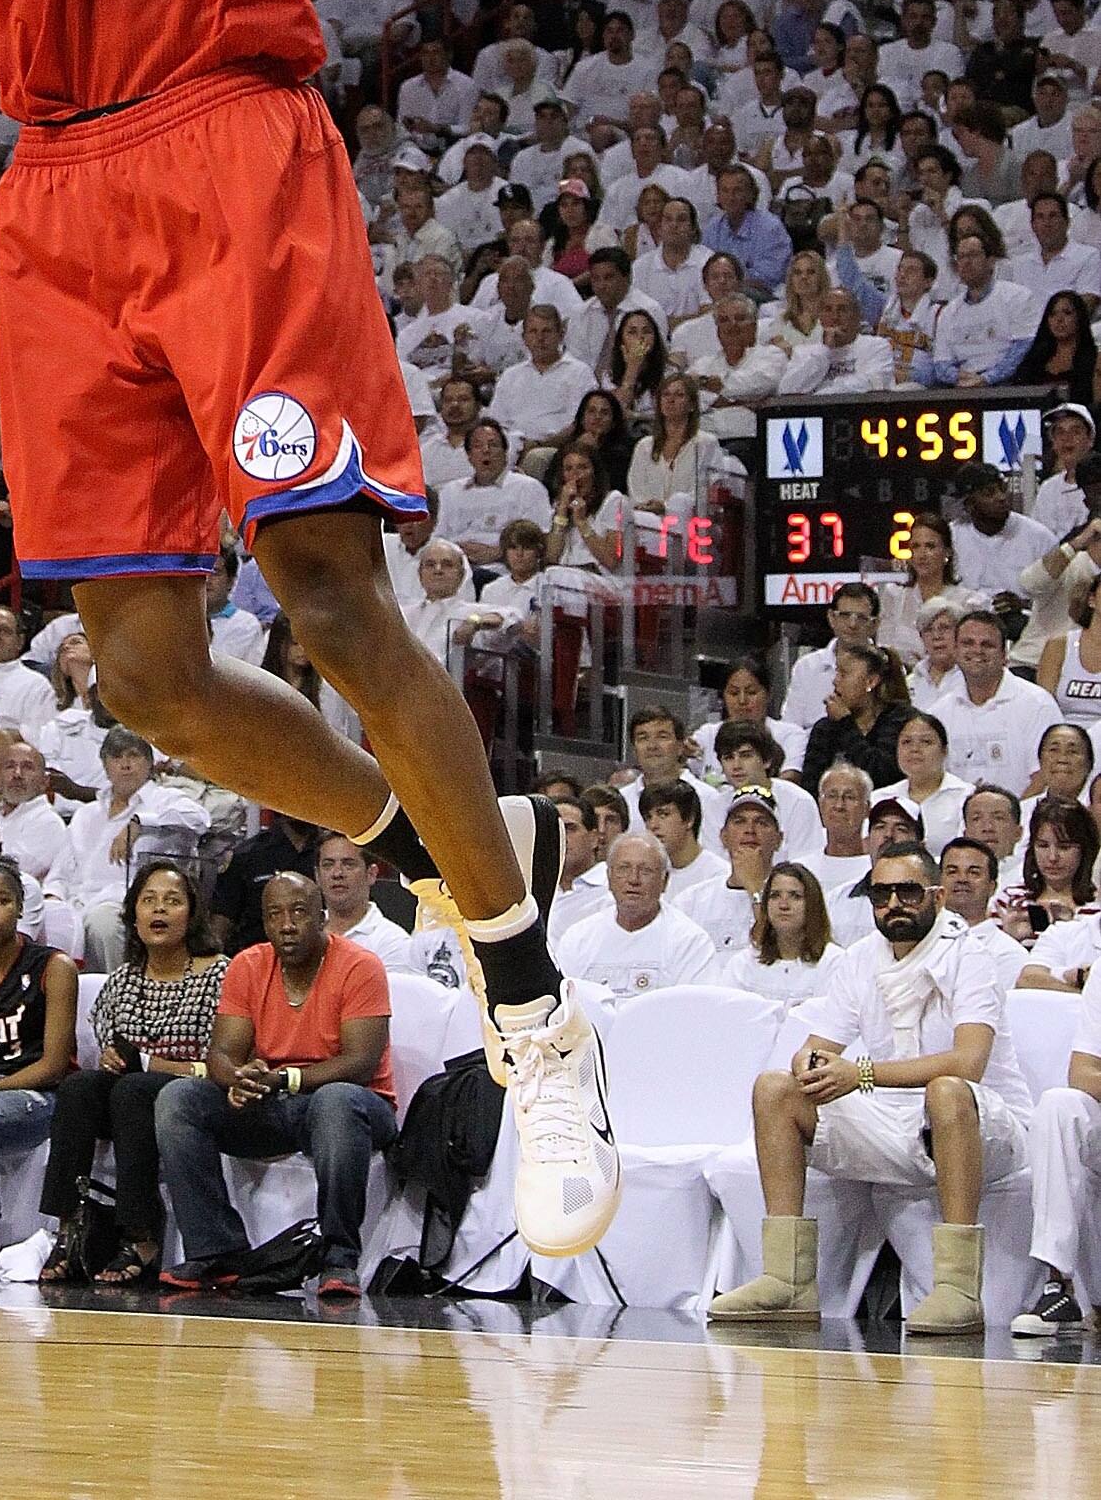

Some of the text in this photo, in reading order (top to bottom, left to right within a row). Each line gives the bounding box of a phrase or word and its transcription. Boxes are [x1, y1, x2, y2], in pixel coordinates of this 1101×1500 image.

[241, 428, 308, 462] 76ers
[861, 411, 977, 461] 4:55
[780, 483, 820, 500] HEAT
[787, 512, 844, 564] 37
